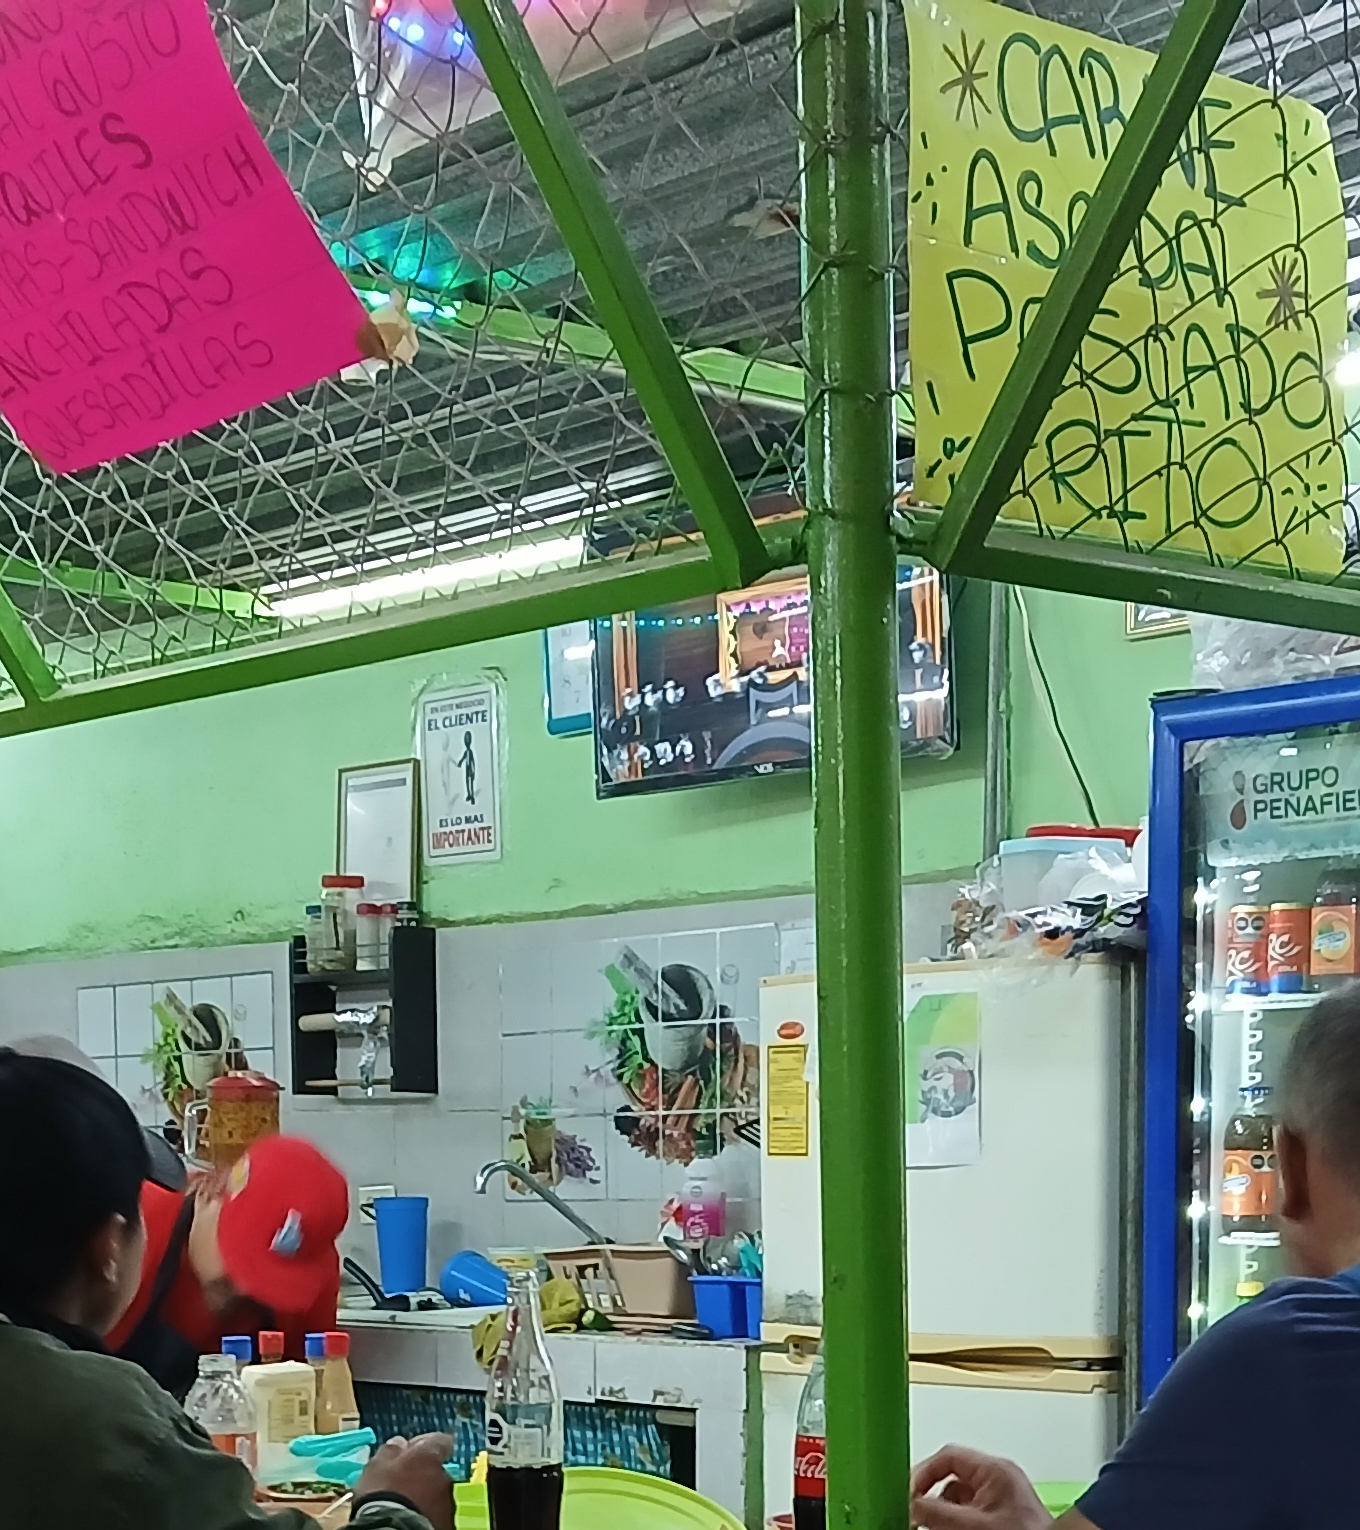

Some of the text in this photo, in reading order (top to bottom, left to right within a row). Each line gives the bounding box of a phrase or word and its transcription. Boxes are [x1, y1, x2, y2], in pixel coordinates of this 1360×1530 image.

[37, 0, 181, 117] GUSTO
[20, 321, 275, 462] QUESADILLAS
[1027, 414, 1264, 535] RITO
[428, 710, 488, 731] EL CLIENTE
[1252, 766, 1339, 795] GRUPO
[432, 826, 492, 850] IMPORTANTE
